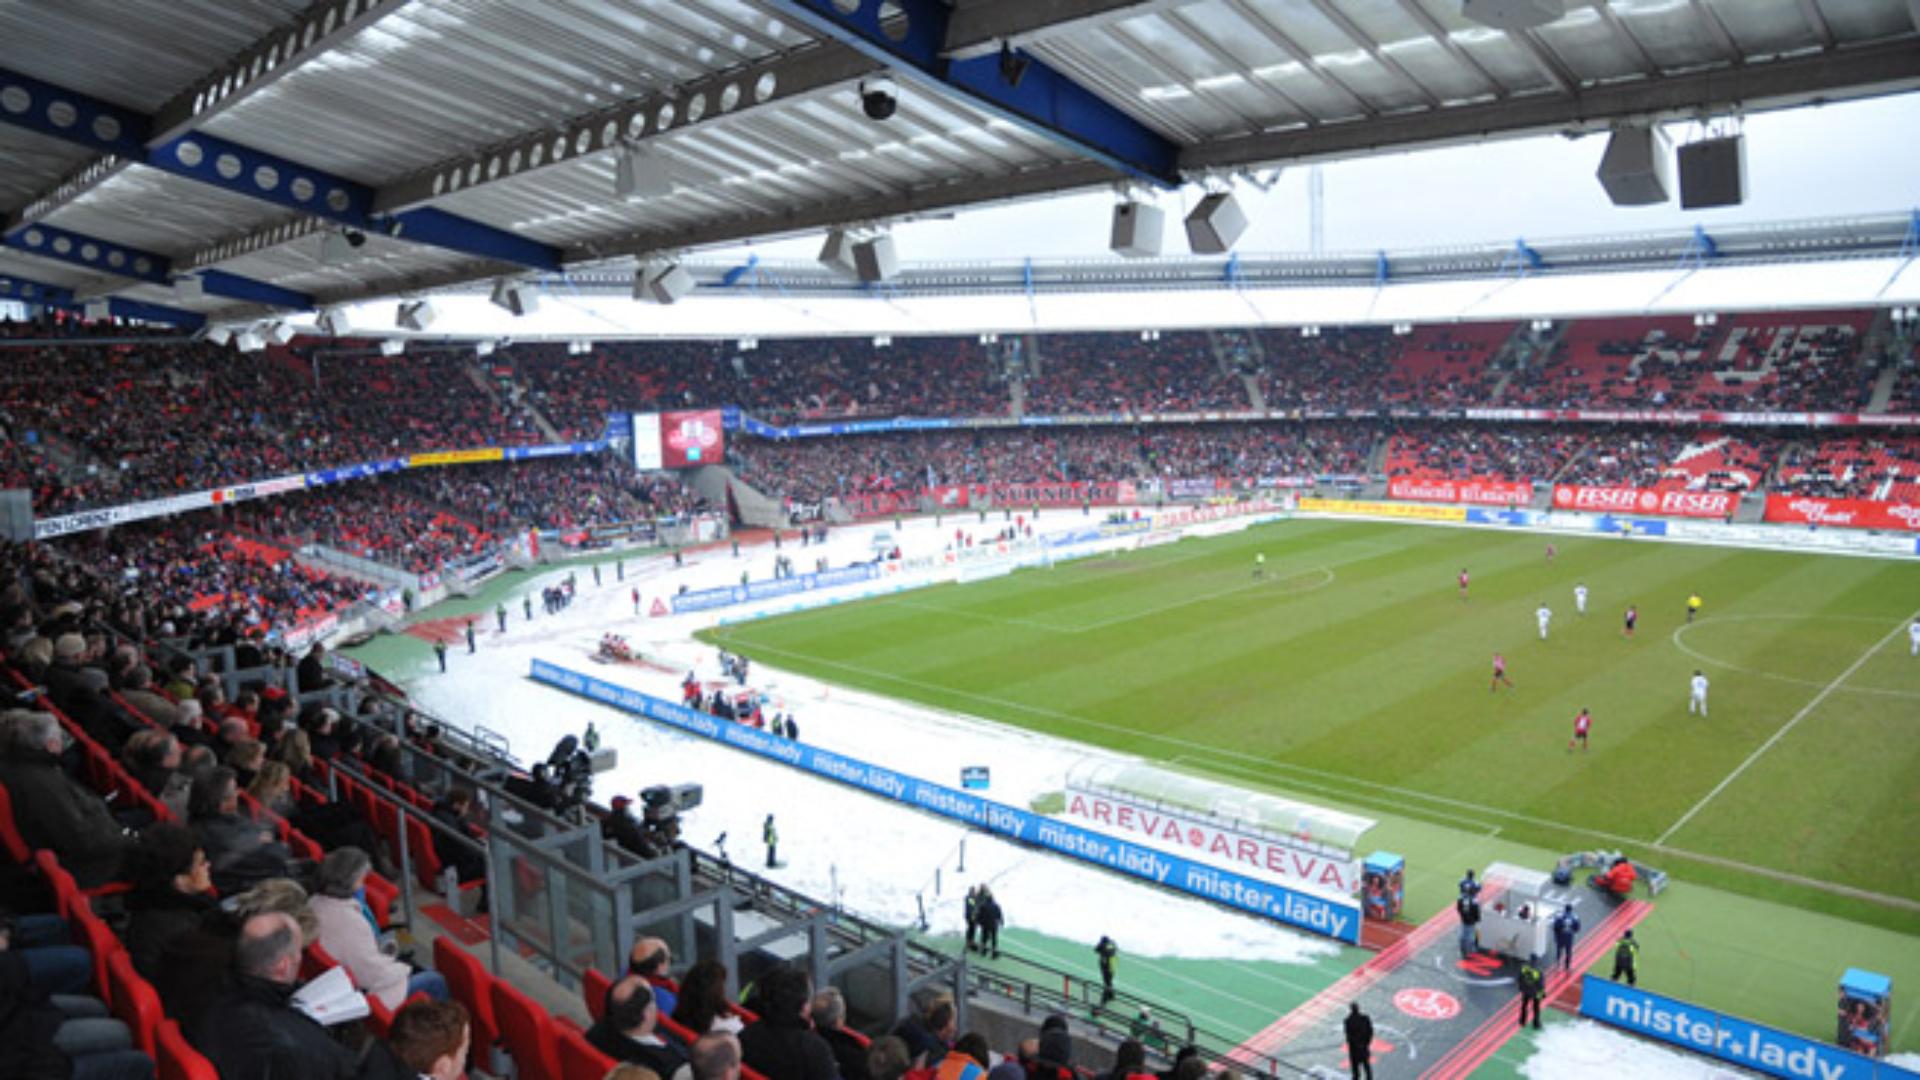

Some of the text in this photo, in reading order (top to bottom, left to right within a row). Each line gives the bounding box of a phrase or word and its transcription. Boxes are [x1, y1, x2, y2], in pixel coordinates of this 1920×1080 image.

[1576, 487, 1730, 513] FESER FESER
[1069, 795, 1346, 890] AREVA AREVA
